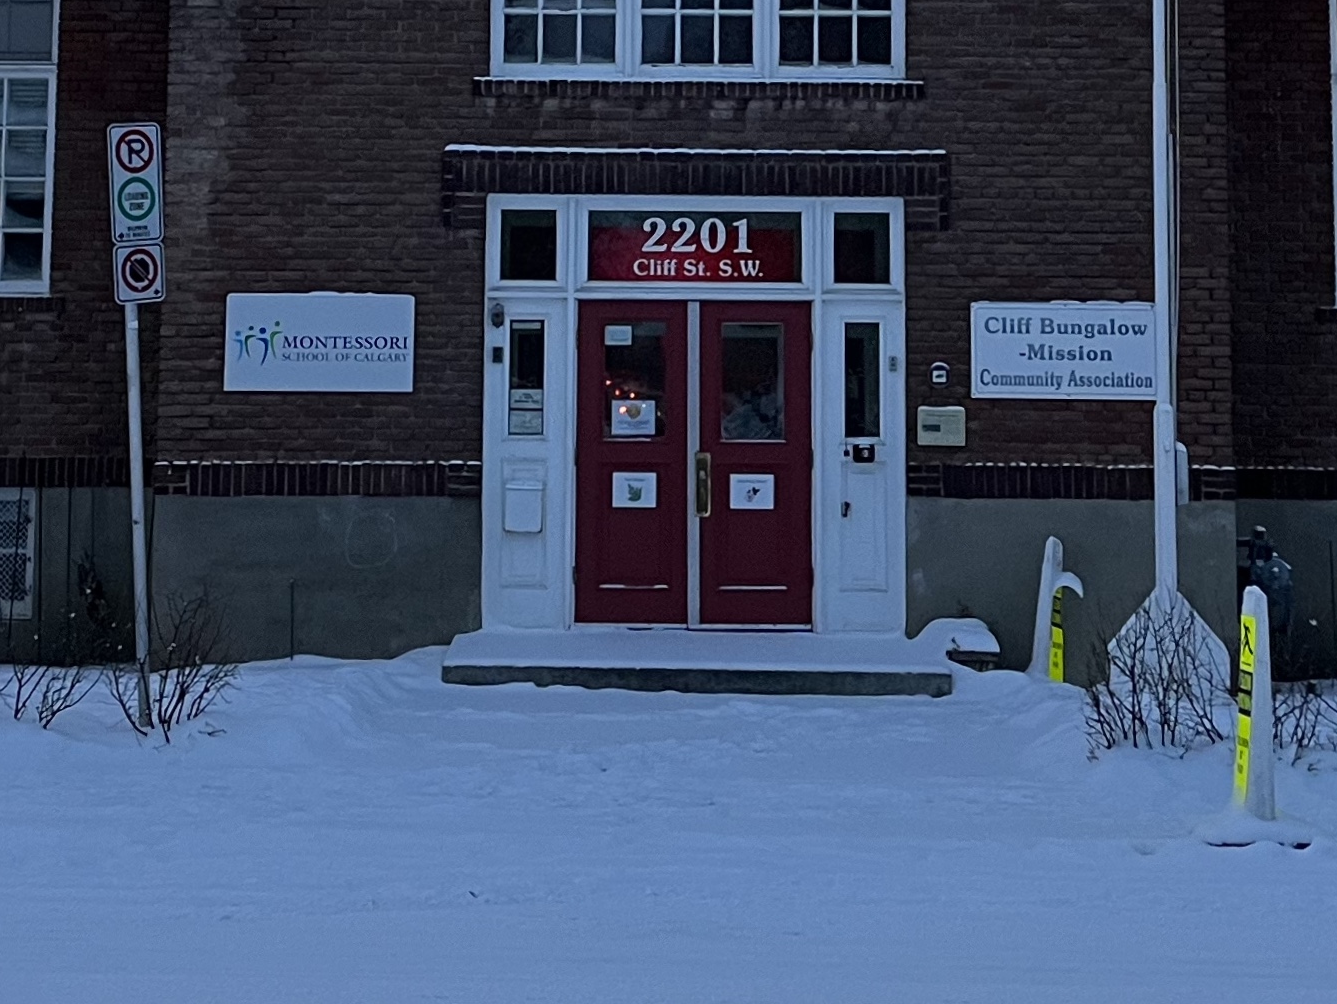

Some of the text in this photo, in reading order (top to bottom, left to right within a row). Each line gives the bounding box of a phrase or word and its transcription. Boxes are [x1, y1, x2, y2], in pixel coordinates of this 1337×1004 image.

[641, 217, 753, 253] 2201
[633, 258, 763, 277] Cliff St. S.W.
[984, 316, 1148, 339] Cliff Bungalow
[282, 335, 408, 350] MONTESSORI
[281, 352, 409, 363] SCHOOL OF CALGARY
[980, 368, 1153, 391] Community Association
